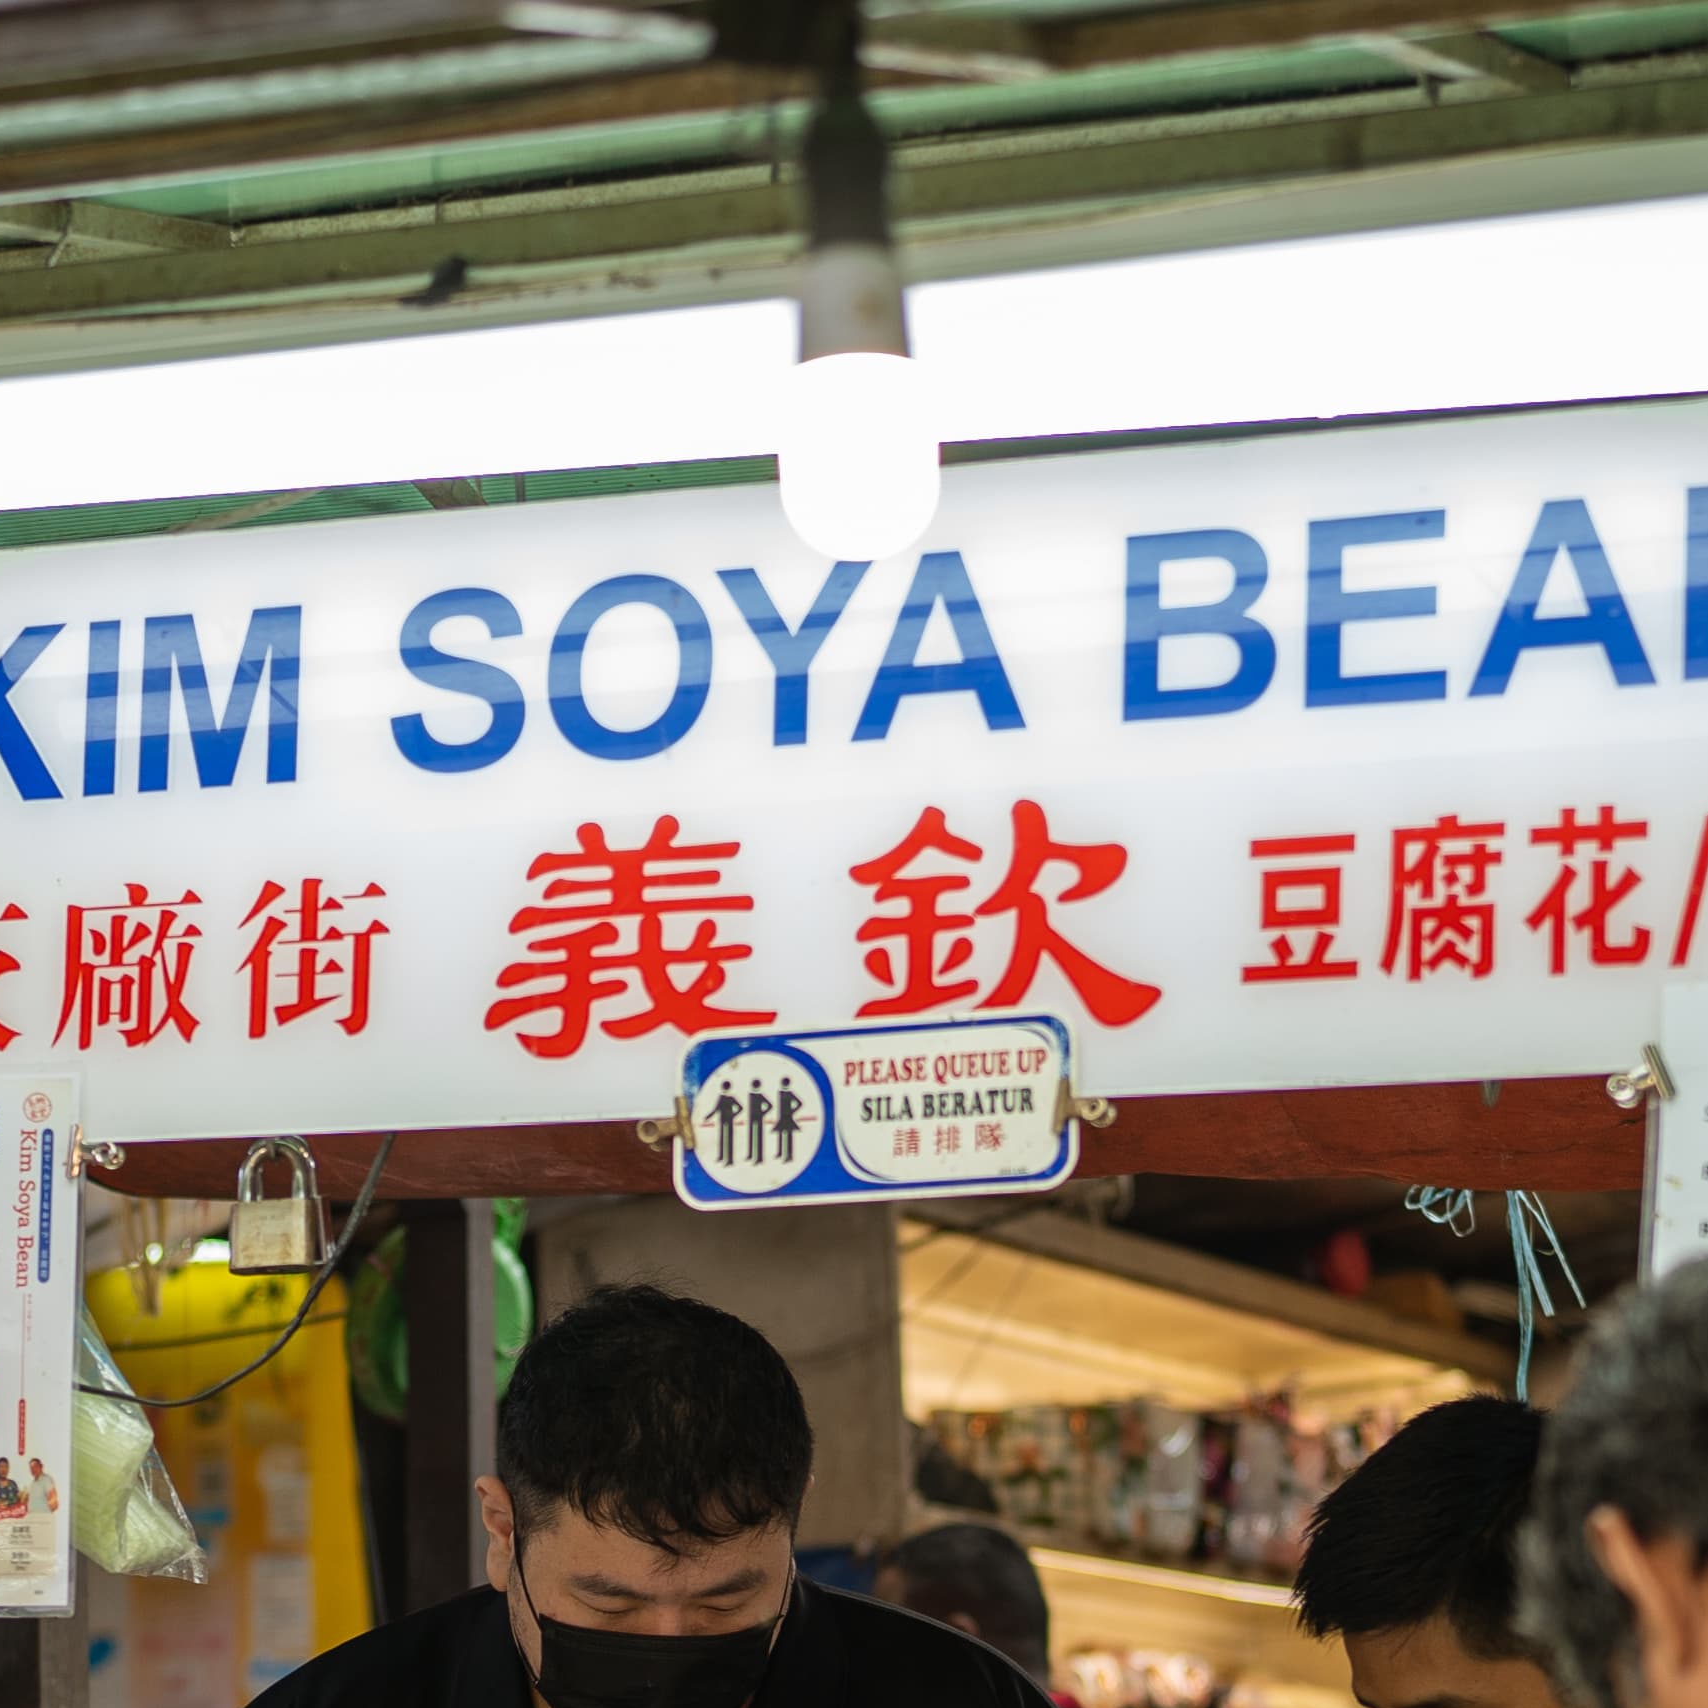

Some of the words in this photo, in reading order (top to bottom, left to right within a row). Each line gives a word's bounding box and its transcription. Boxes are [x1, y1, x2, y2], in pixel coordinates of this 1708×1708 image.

[391, 550, 1027, 774] SOYA
[484, 799, 1162, 1060] 義欽
[843, 1056, 928, 1087] PLEASE
[932, 1051, 1010, 1085] QUEUE
[1015, 1047, 1048, 1076] UP
[860, 1094, 913, 1124] SILA
[922, 1087, 1035, 1119] BERATUR
[19, 1128, 39, 1174] Kim
[892, 1121, 1006, 1159] 請排隊
[12, 1179, 37, 1229] Soya
[15, 1234, 35, 1289] Bean
